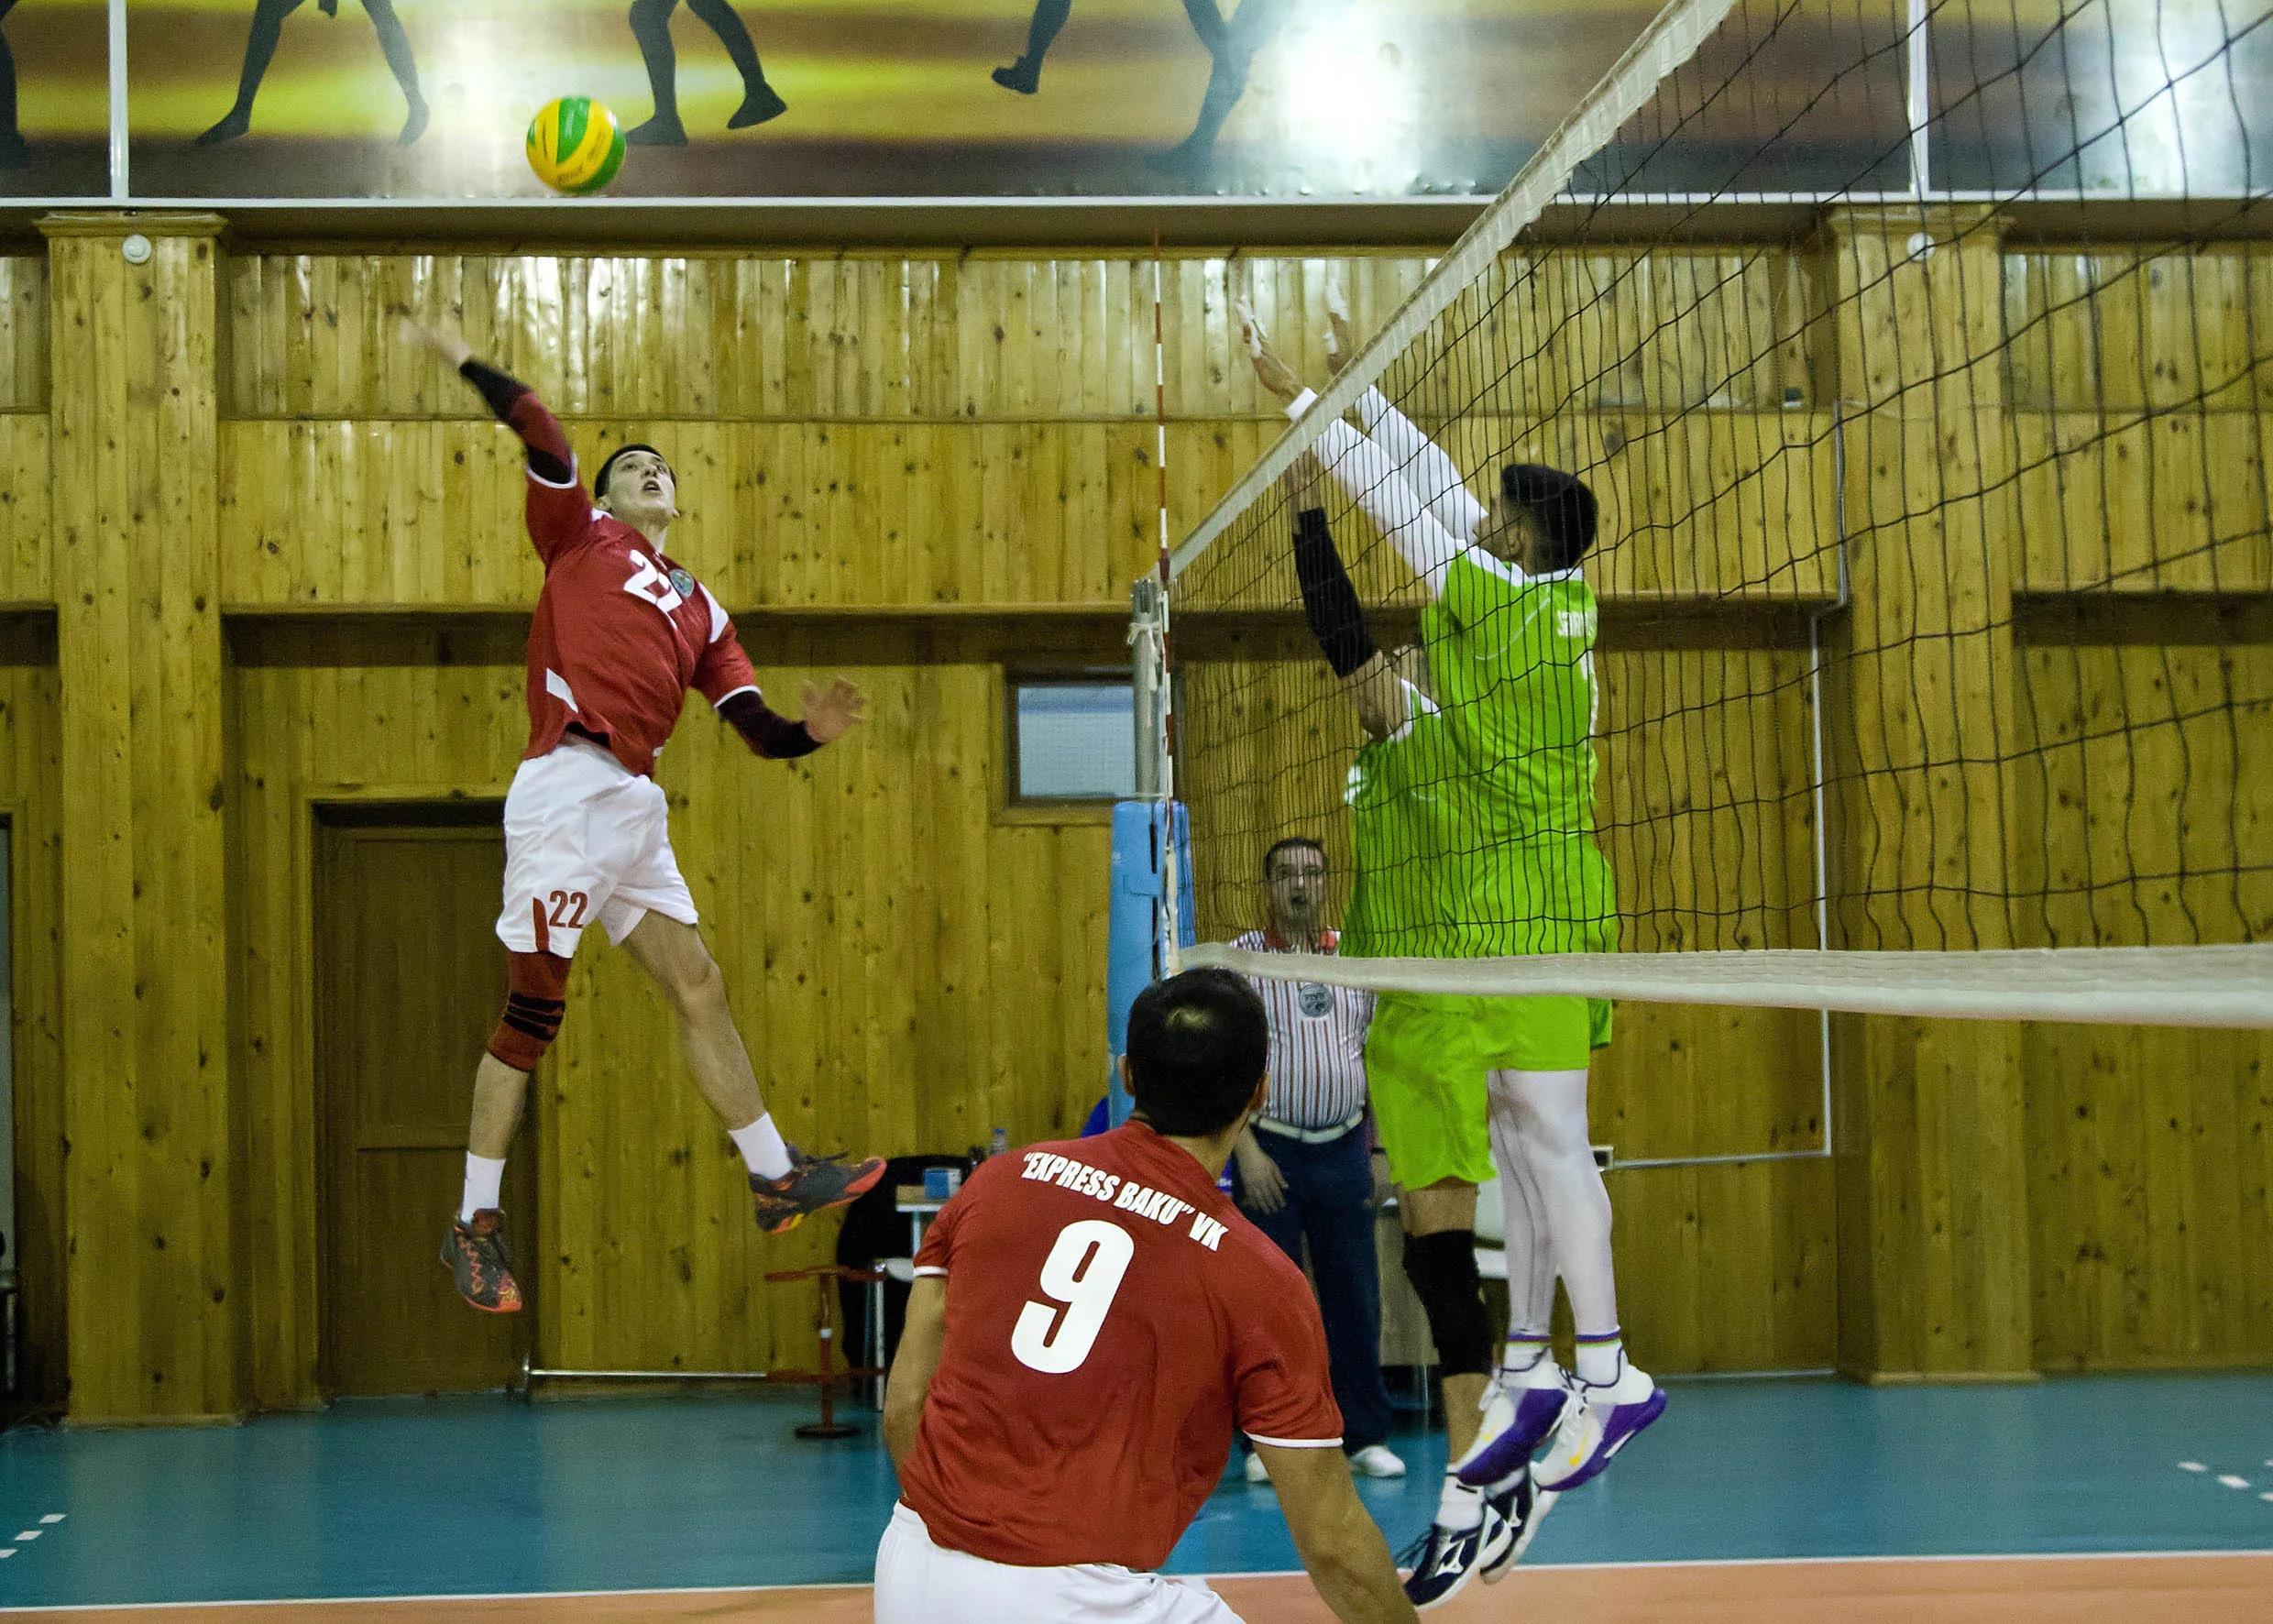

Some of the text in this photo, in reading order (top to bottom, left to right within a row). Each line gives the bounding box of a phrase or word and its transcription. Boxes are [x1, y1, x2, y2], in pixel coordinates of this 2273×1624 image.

[549, 890, 587, 928] 22
[1189, 1213, 1228, 1251] VK
[1011, 1220, 1135, 1374] 9
